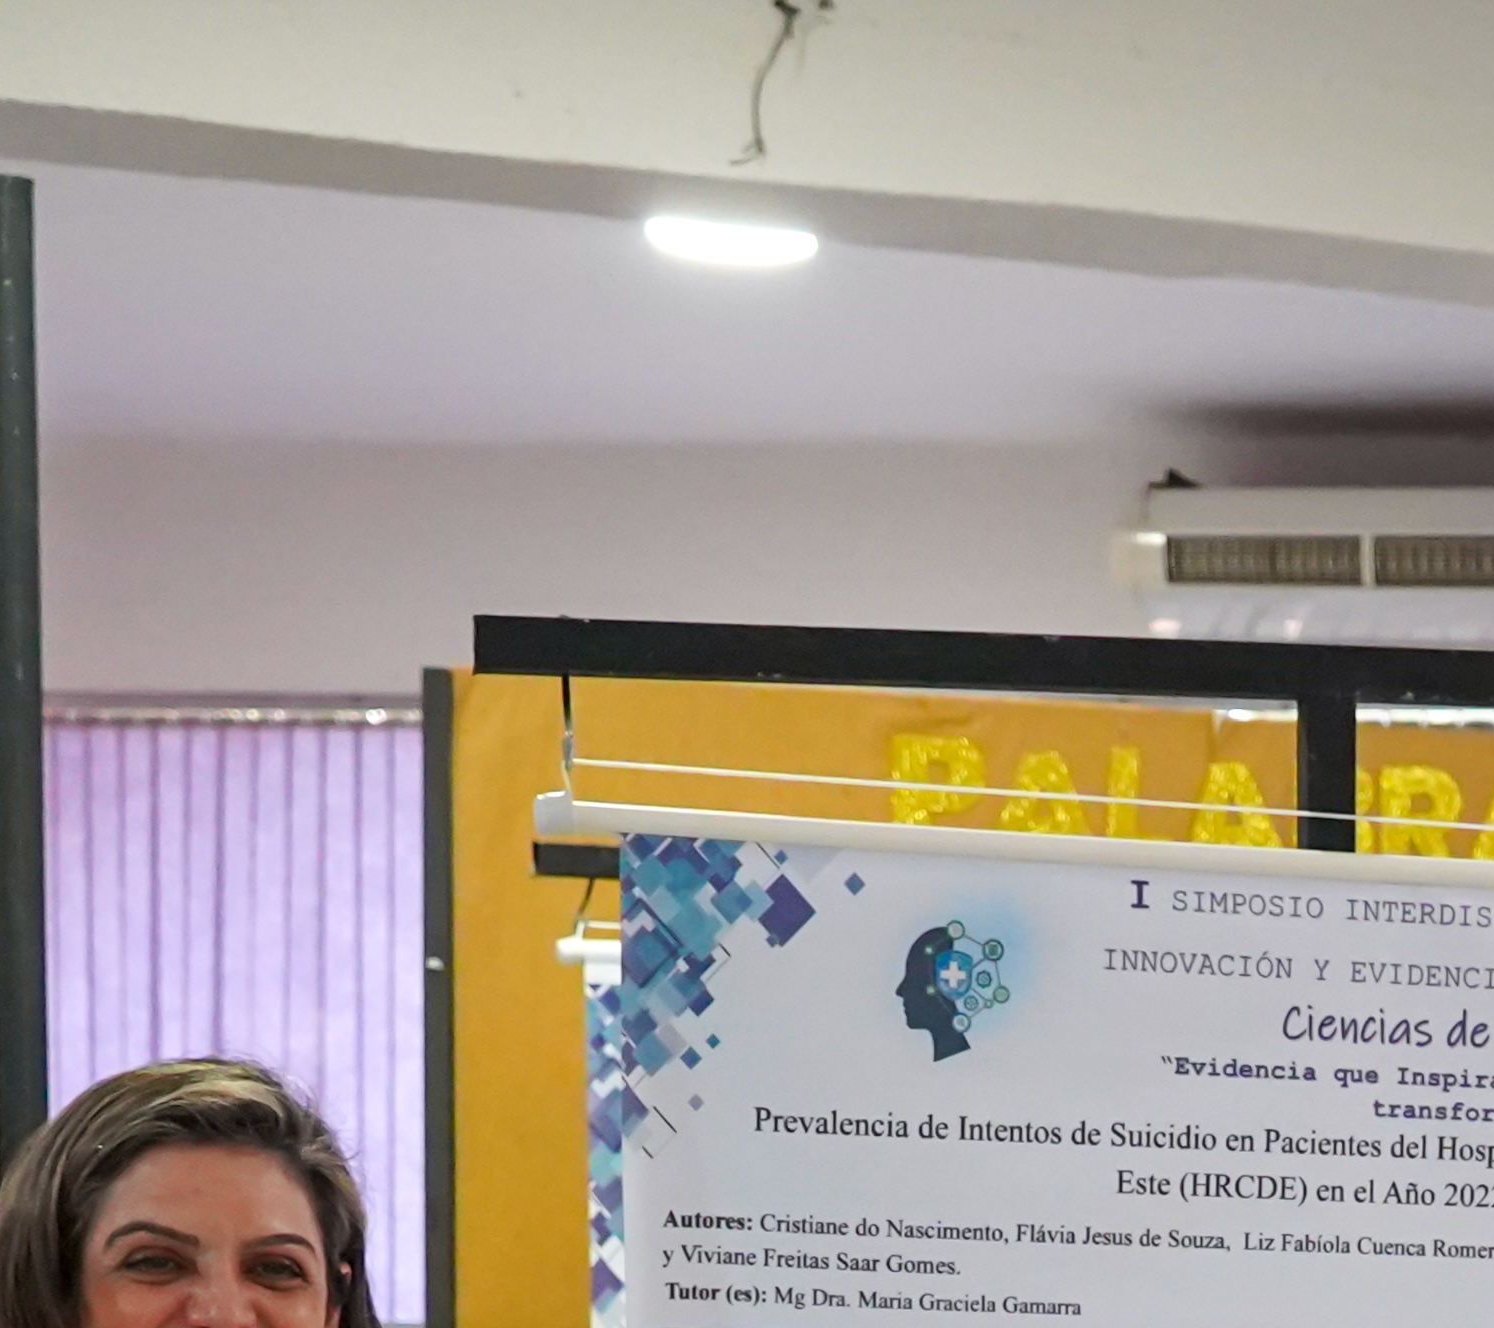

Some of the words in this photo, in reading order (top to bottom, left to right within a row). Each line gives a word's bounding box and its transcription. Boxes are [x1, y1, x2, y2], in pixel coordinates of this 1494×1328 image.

[1129, 879, 1151, 910] I
[1171, 889, 1324, 920] SIMPOSIO
[1103, 948, 1293, 979] INNOVACIÓN
[1313, 958, 1331, 982] Y
[1282, 1004, 1433, 1048] Ciencias
[1446, 1008, 1491, 1049] de
[1333, 1067, 1379, 1089] que
[754, 1106, 909, 1139] Prevalencia
[918, 1113, 949, 1140] de
[958, 1115, 1063, 1145] Intentos
[1070, 1120, 1102, 1146] de
[1110, 1122, 1217, 1151] Suicidio
[1225, 1133, 1255, 1152] en
[1264, 1128, 1382, 1158] Pacientes
[1390, 1133, 1427, 1160] del
[1116, 1169, 1171, 1196] Este
[1179, 1172, 1308, 1207] (HRCDE)
[1315, 1184, 1345, 1203] en
[1353, 1178, 1375, 1204] el
[1382, 1180, 1436, 1206] Año
[662, 1209, 753, 1231] Autores:
[759, 1213, 850, 1236] Cristiane
[854, 1217, 880, 1237] do
[885, 1219, 1009, 1245] Nascimento,
[1015, 1223, 1076, 1245] Flávia
[1081, 1226, 1133, 1247] Jesus
[1138, 1228, 1162, 1248] de
[1167, 1229, 1231, 1252] Souza,
[1243, 1232, 1276, 1252] Liz
[1281, 1233, 1351, 1254] Fabíola
